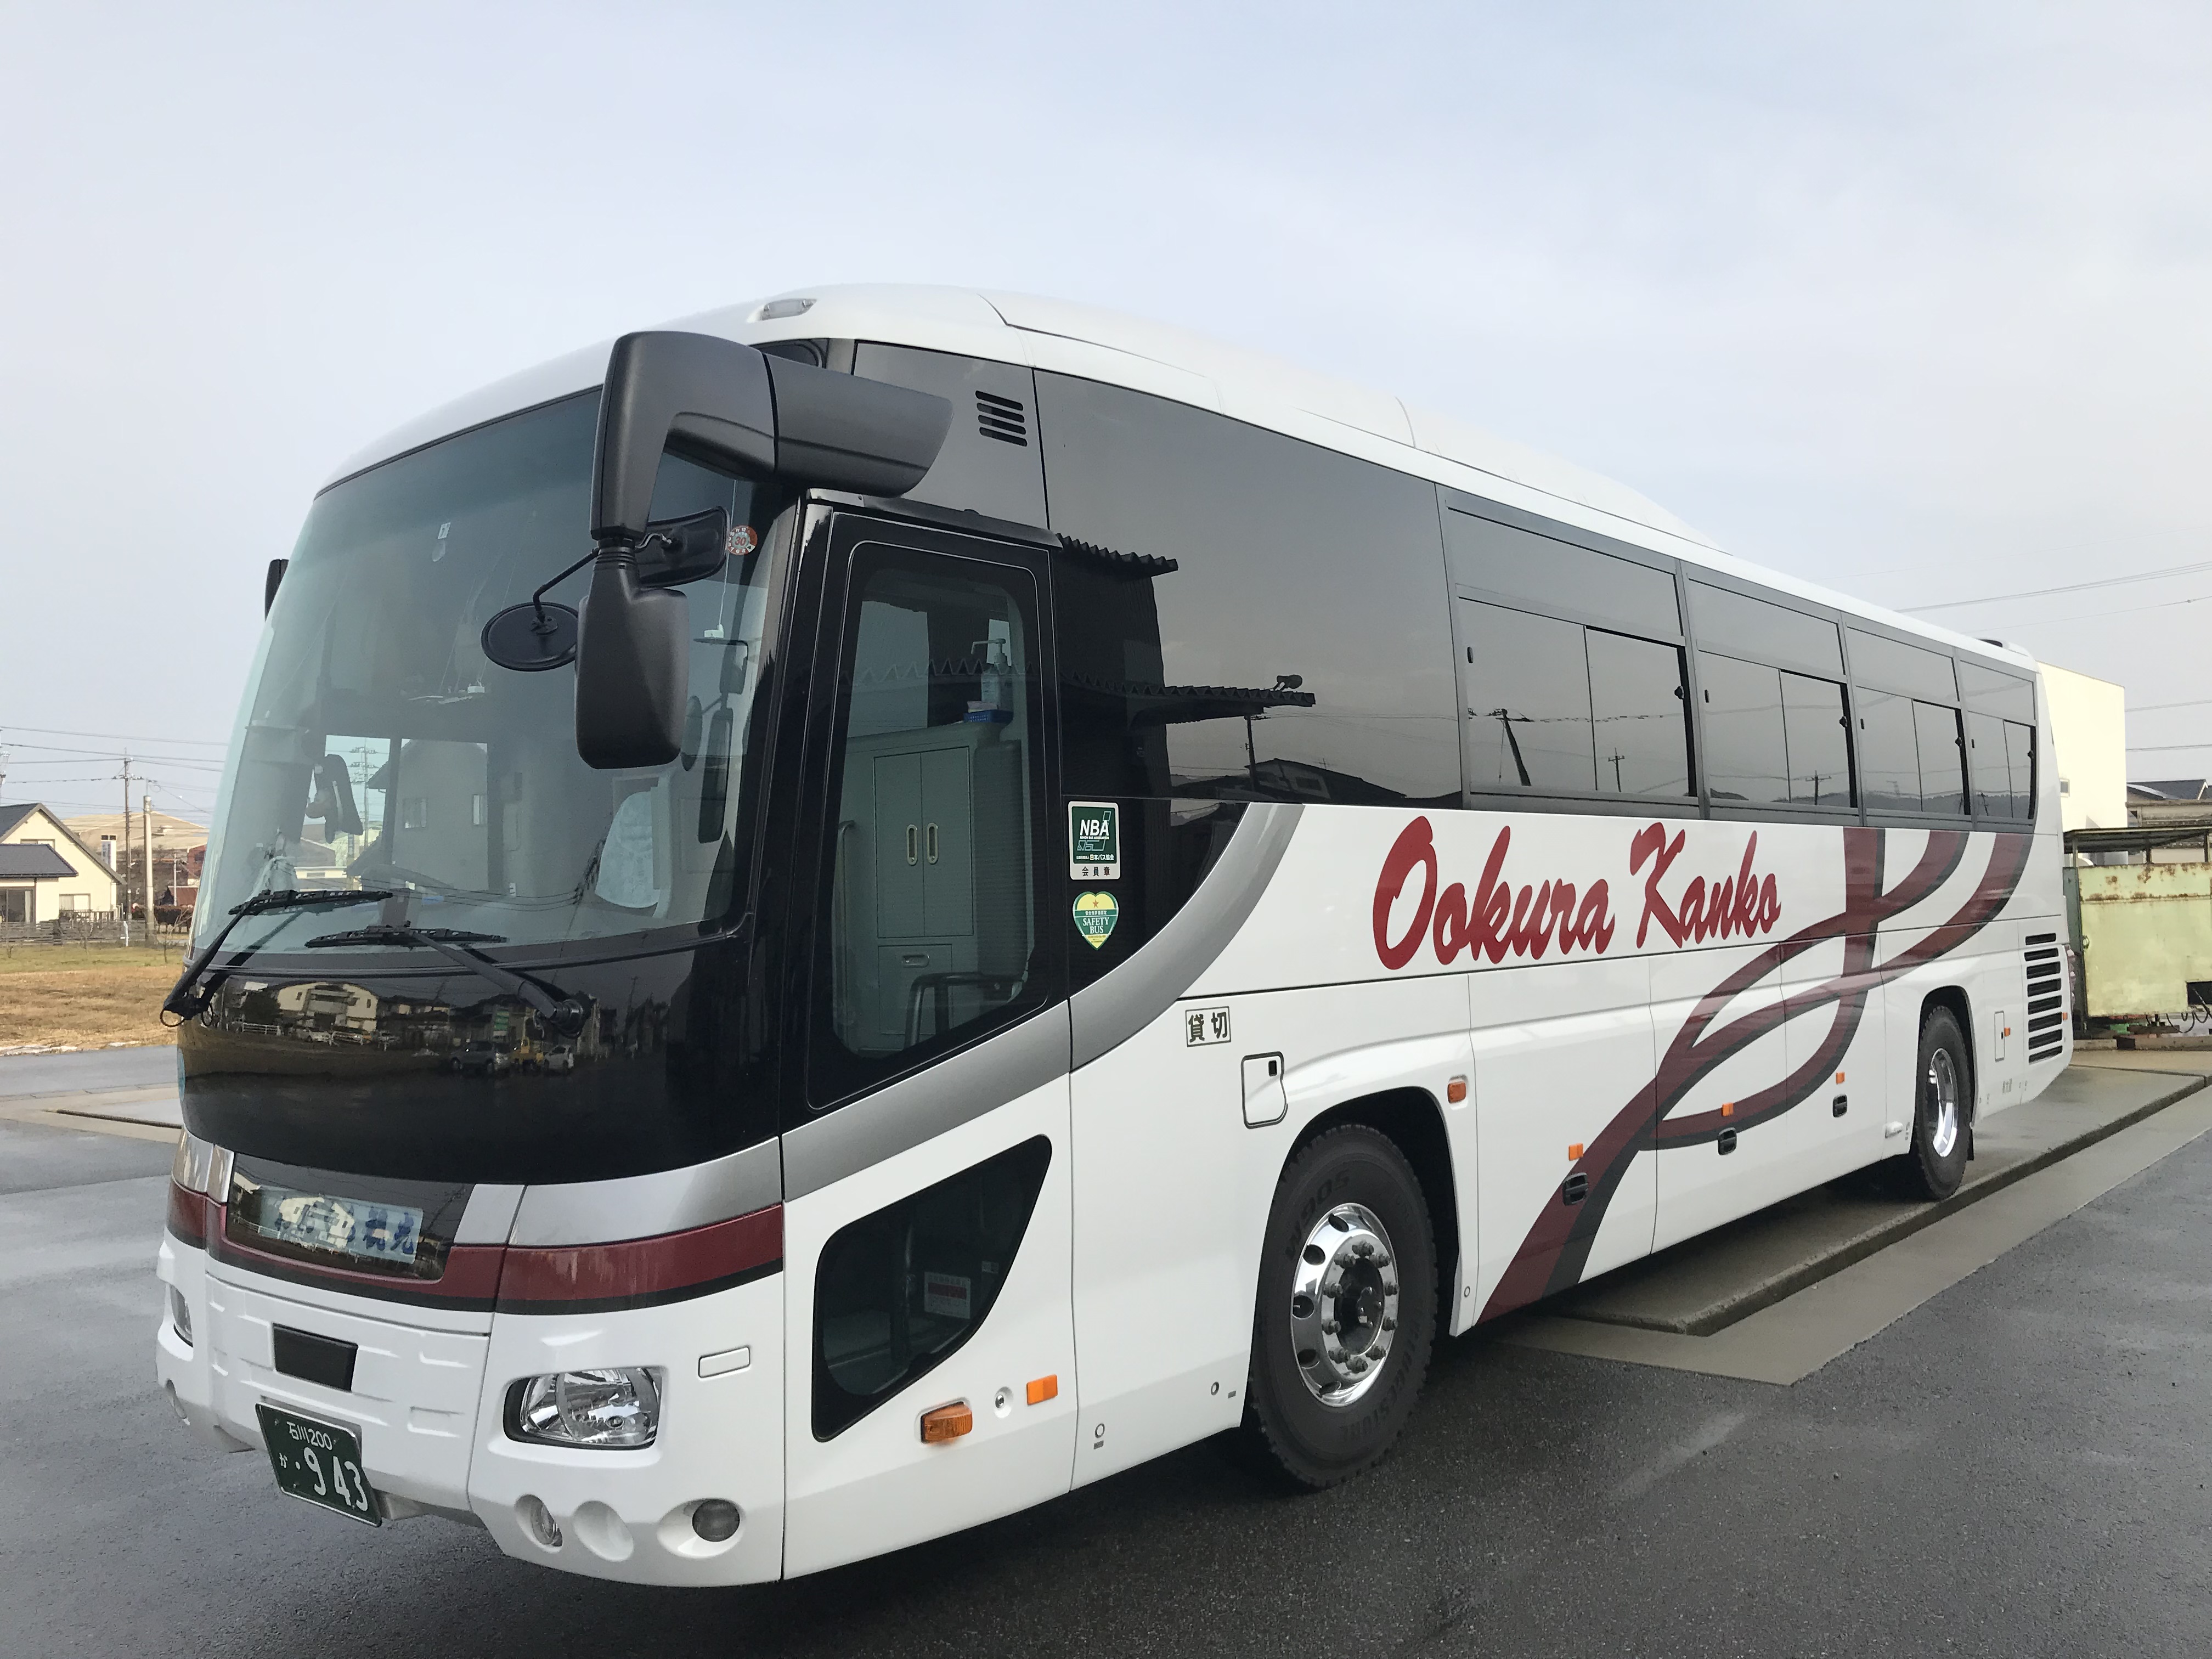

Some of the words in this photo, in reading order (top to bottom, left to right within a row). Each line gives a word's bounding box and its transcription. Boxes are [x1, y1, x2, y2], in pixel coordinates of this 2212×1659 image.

[1080, 819, 1109, 836] NBA
[1081, 866, 1110, 877] 会員章
[1373, 816, 1615, 970] Ookura
[1630, 822, 1782, 949] Kanko
[1082, 917, 1109, 926] SAFETY
[1090, 926, 1104, 934] BUS
[1188, 1012, 1228, 1043] 貸切
[279, 1452, 288, 1469] か
